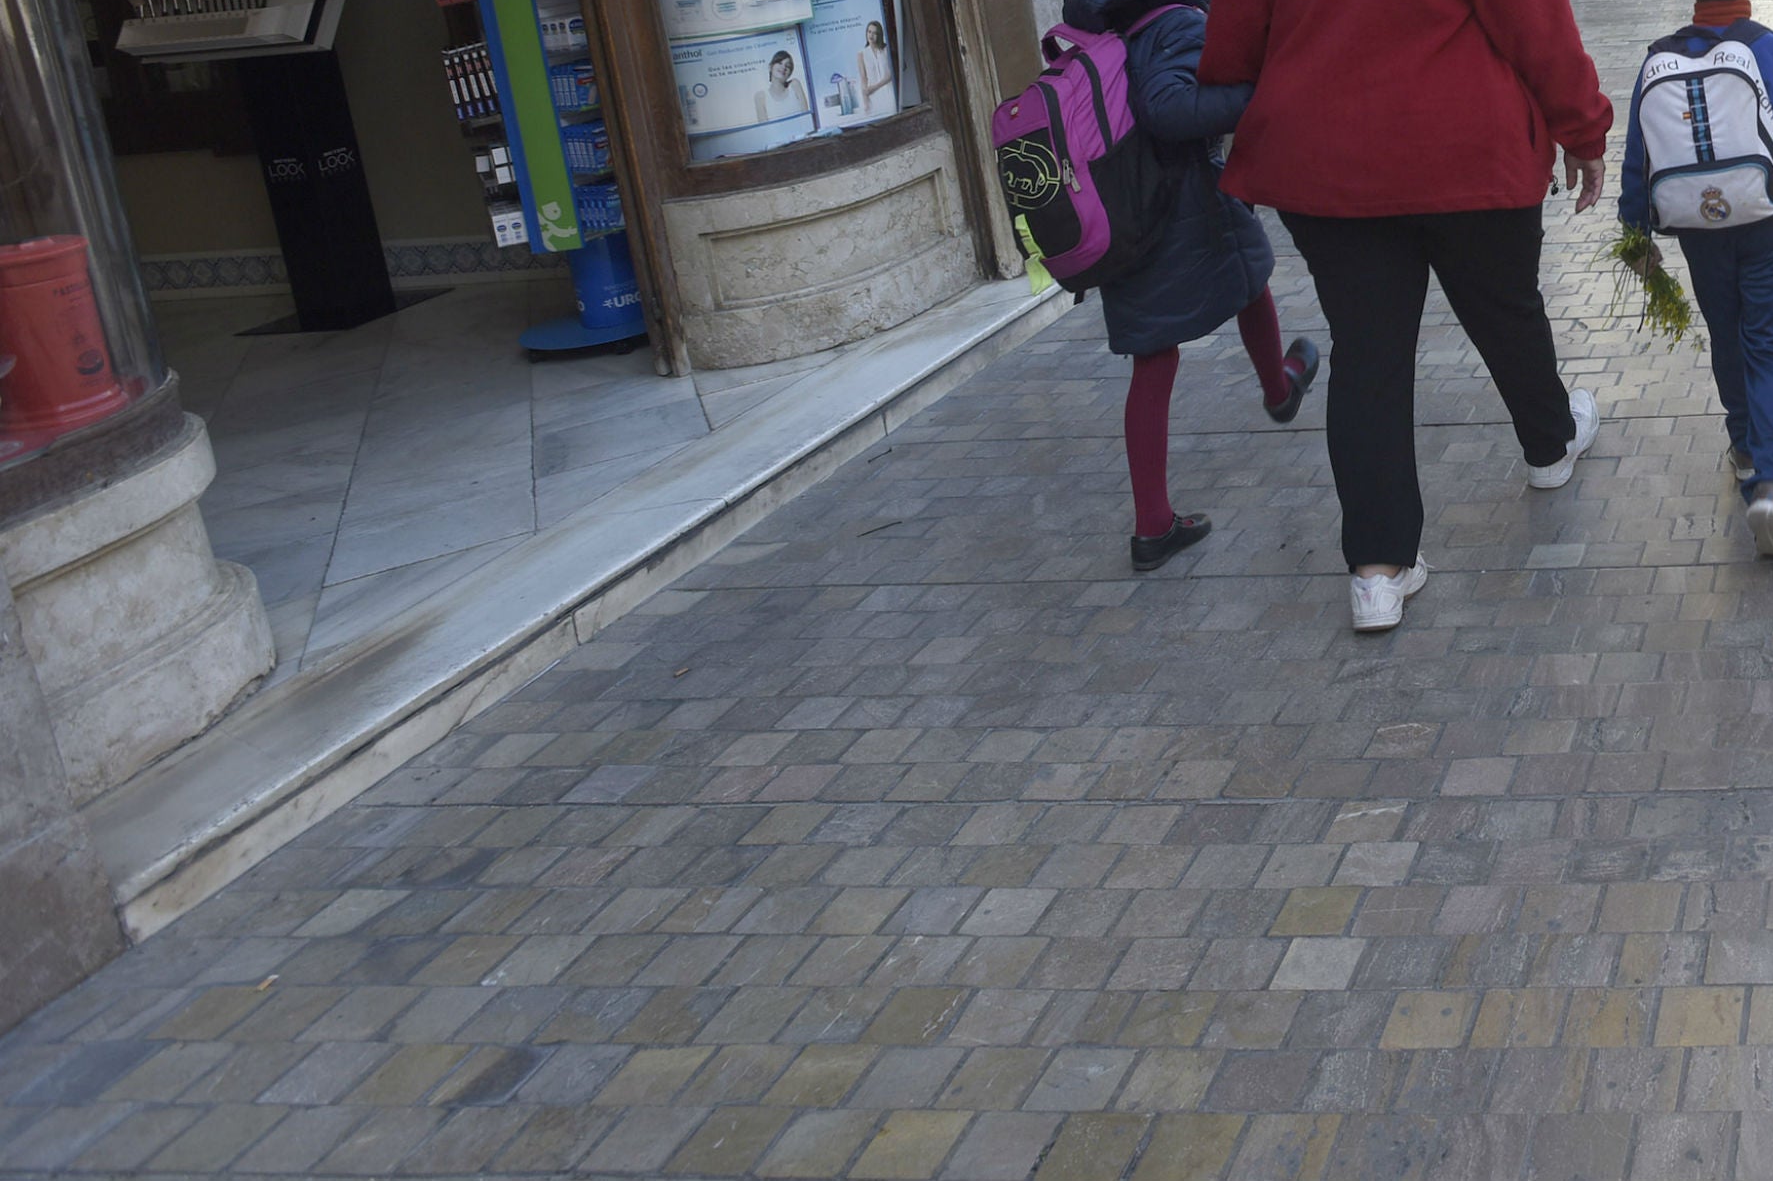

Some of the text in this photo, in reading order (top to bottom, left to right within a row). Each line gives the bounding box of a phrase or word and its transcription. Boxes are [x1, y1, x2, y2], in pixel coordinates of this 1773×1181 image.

[1713, 51, 1751, 70] Real
[268, 162, 305, 177] LOOK
[318, 151, 355, 171] LOOK
